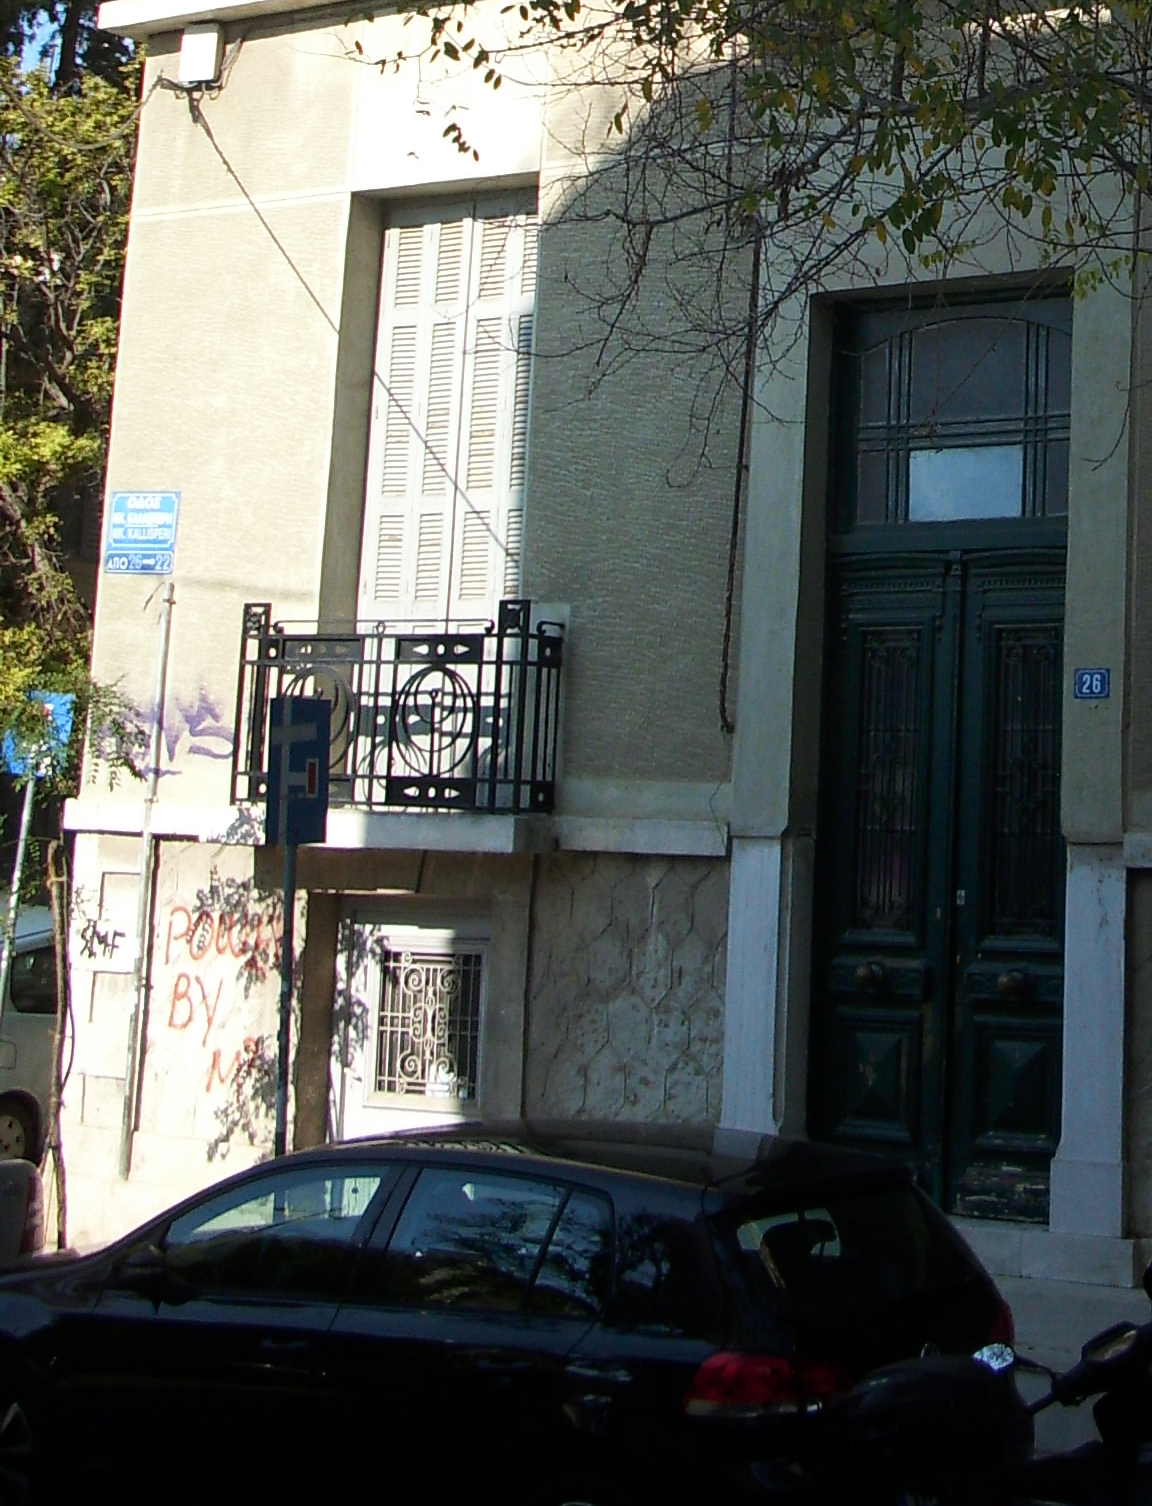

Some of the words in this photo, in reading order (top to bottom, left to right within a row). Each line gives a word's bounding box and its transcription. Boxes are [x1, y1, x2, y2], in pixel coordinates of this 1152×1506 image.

[155, 554, 170, 570] 22
[1082, 673, 1101, 693] 26
[169, 972, 223, 1047] BY
